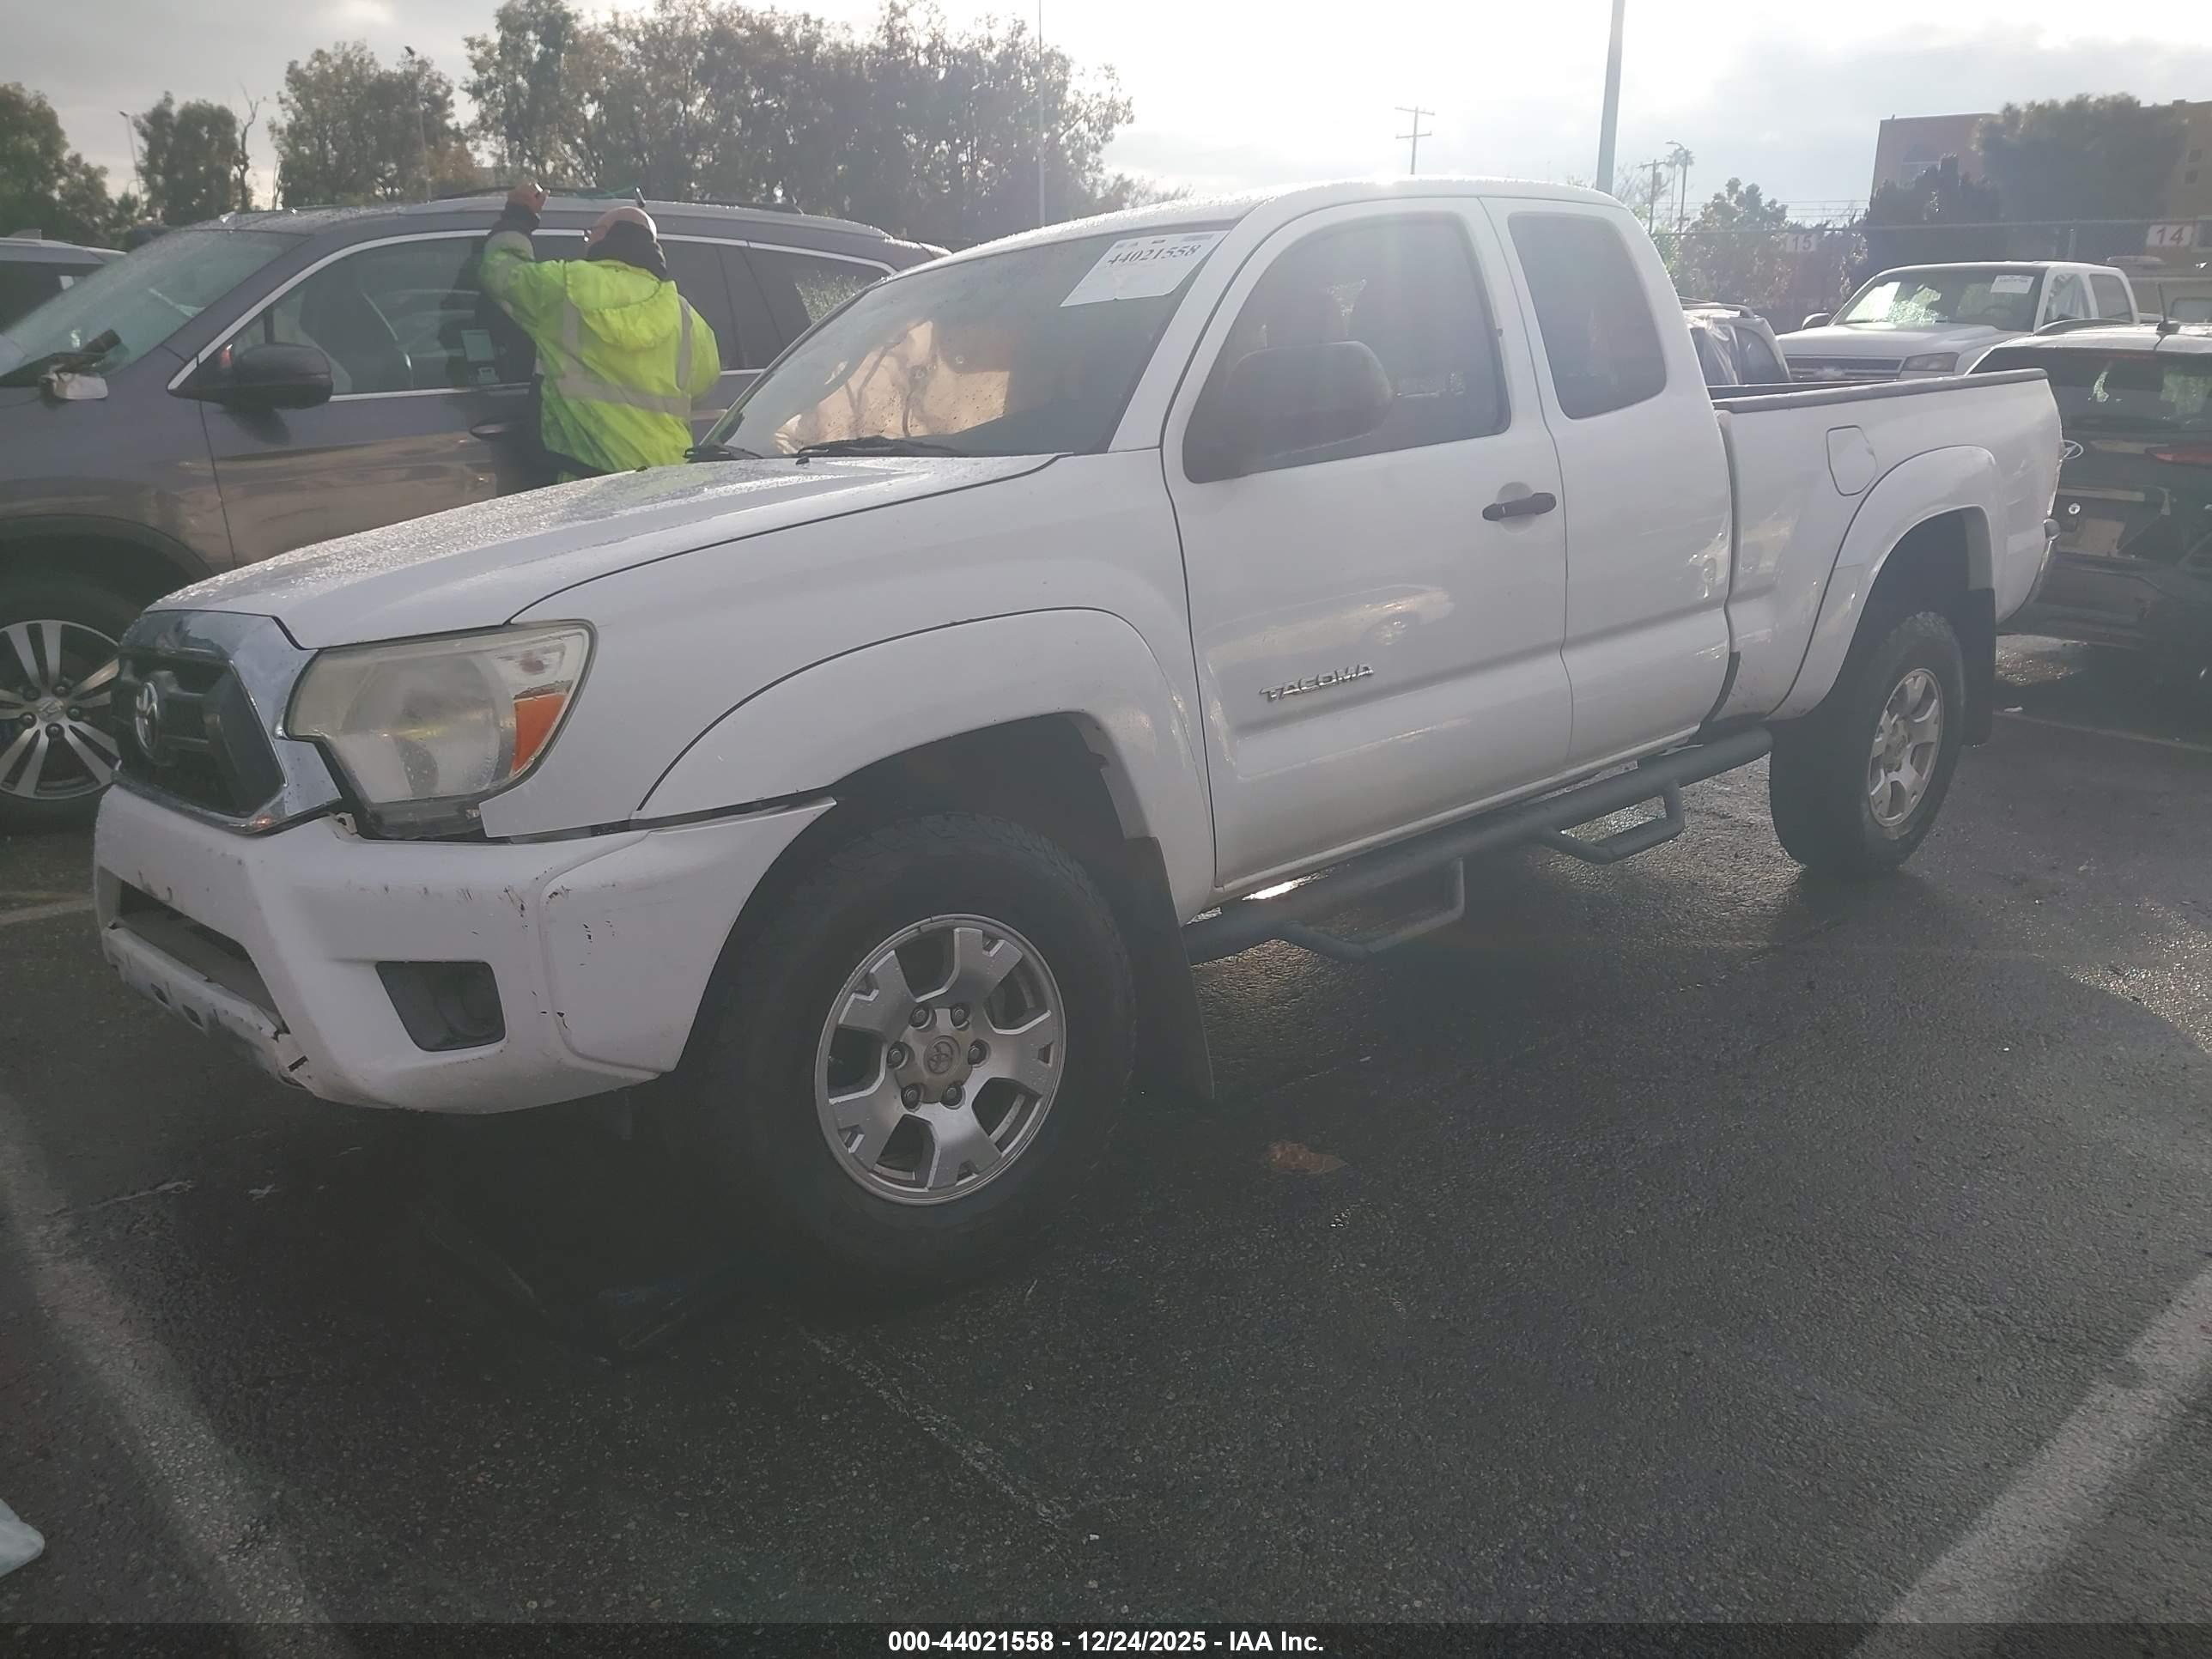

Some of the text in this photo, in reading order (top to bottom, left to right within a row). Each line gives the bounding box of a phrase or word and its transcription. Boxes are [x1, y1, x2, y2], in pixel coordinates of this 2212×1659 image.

[1792, 234, 1812, 250] 15
[2156, 226, 2185, 246] 14
[1107, 245, 1202, 264] 44021558
[1259, 664, 1375, 702] TACOMA
